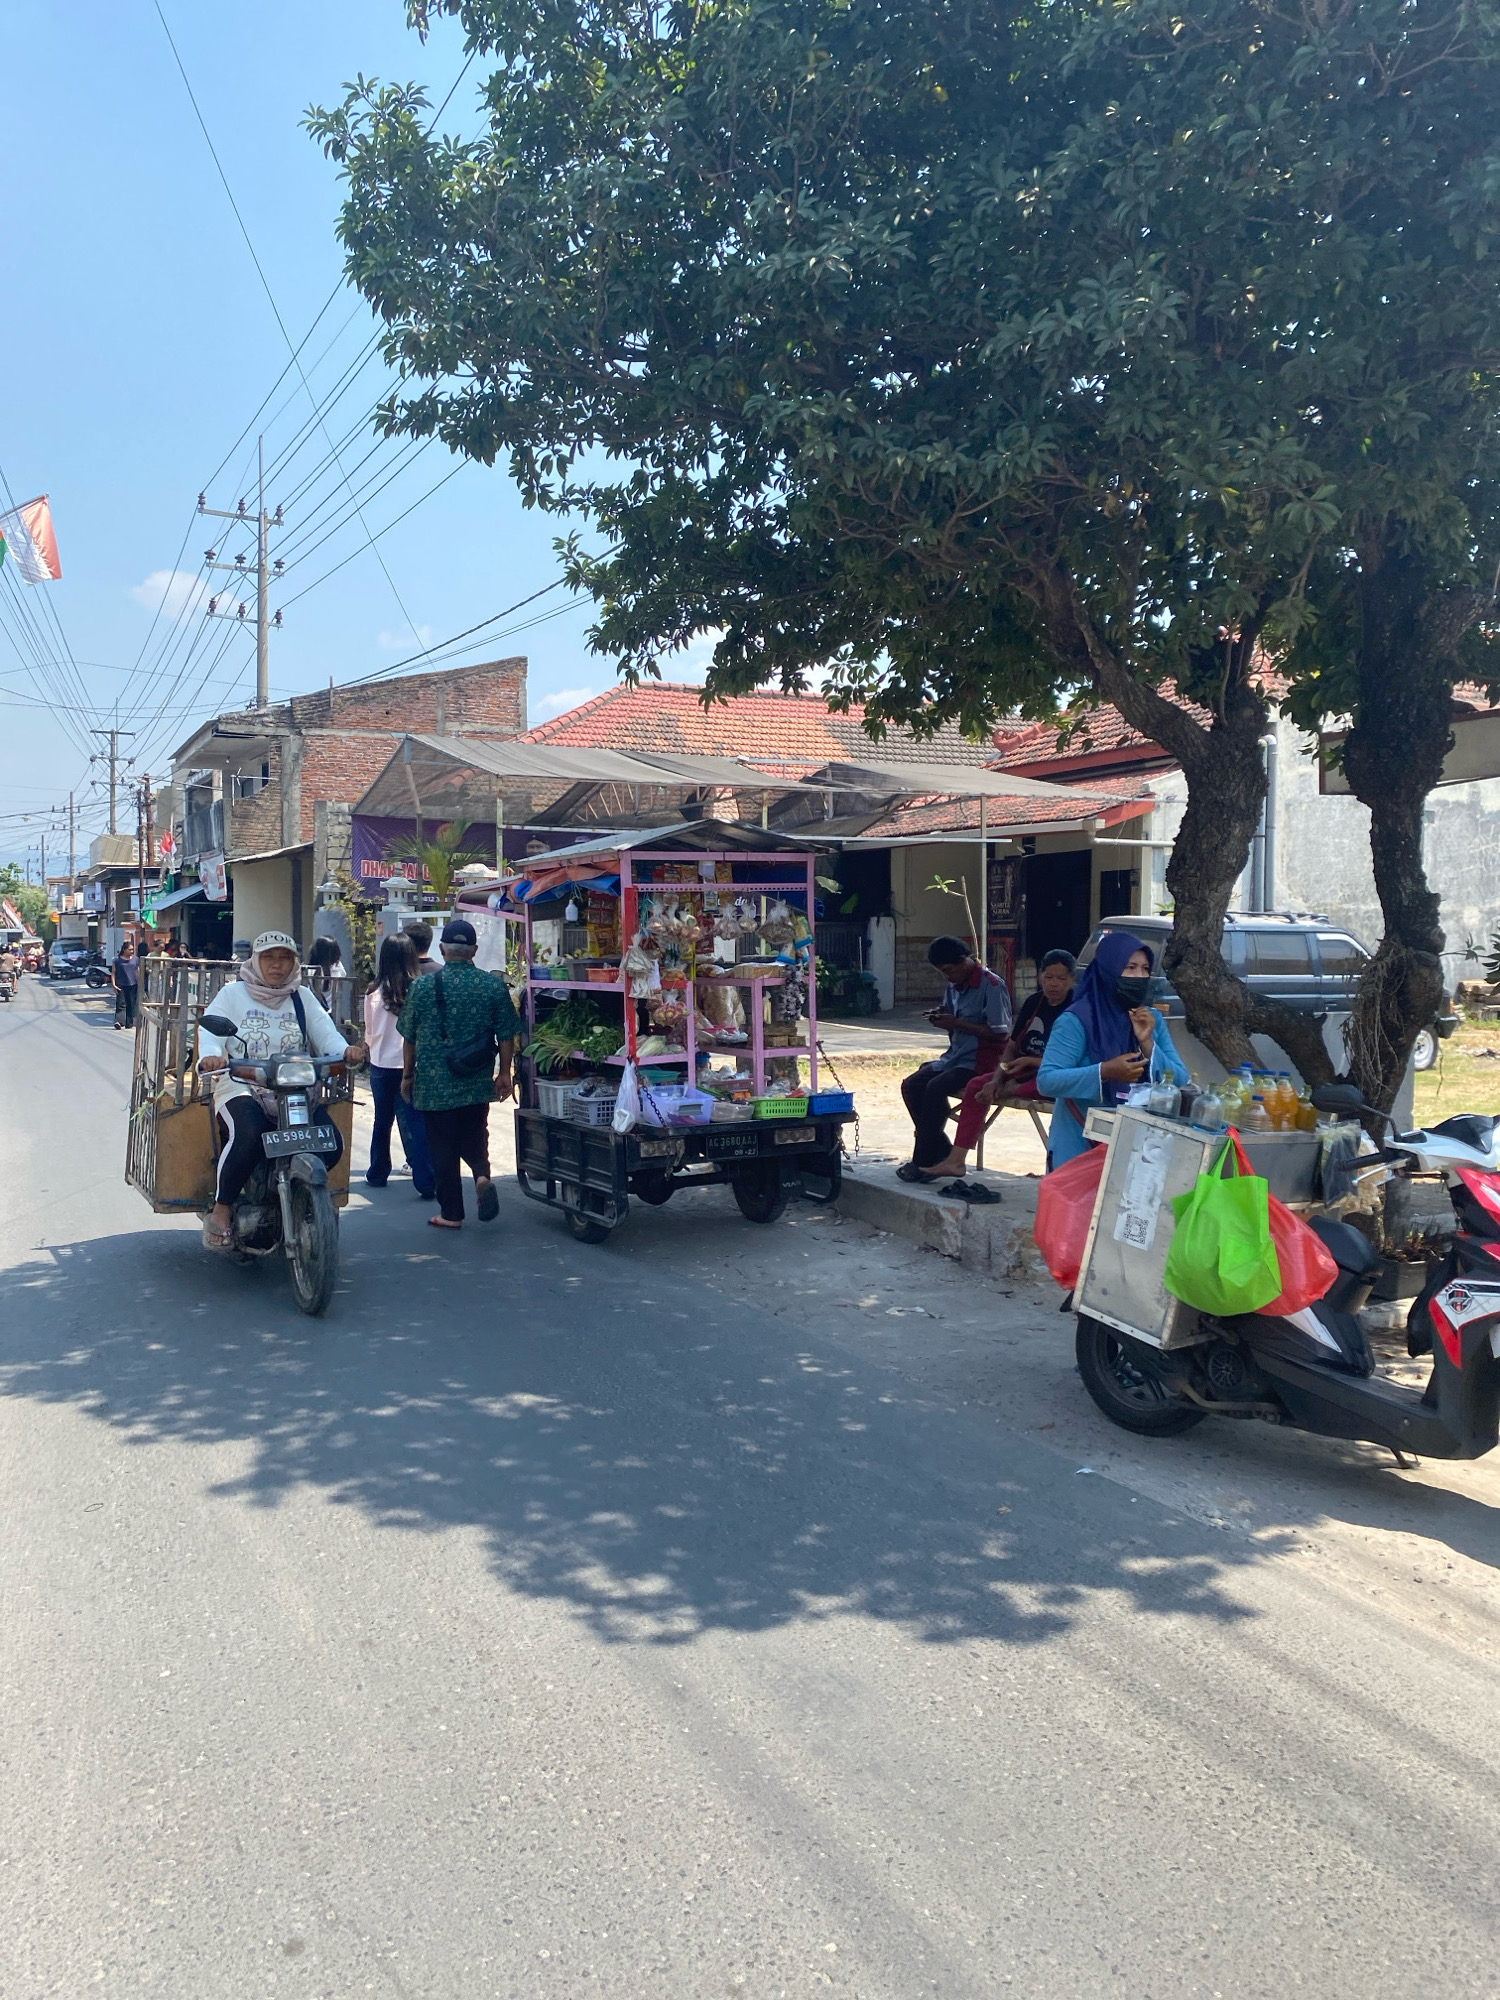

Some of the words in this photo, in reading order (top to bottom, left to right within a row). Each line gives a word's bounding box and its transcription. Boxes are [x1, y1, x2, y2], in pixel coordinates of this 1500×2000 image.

[256, 935, 292, 946] SPOR
[266, 1133, 280, 1145] AG
[283, 1129, 312, 1142] 5984
[317, 1127, 330, 1138] AY
